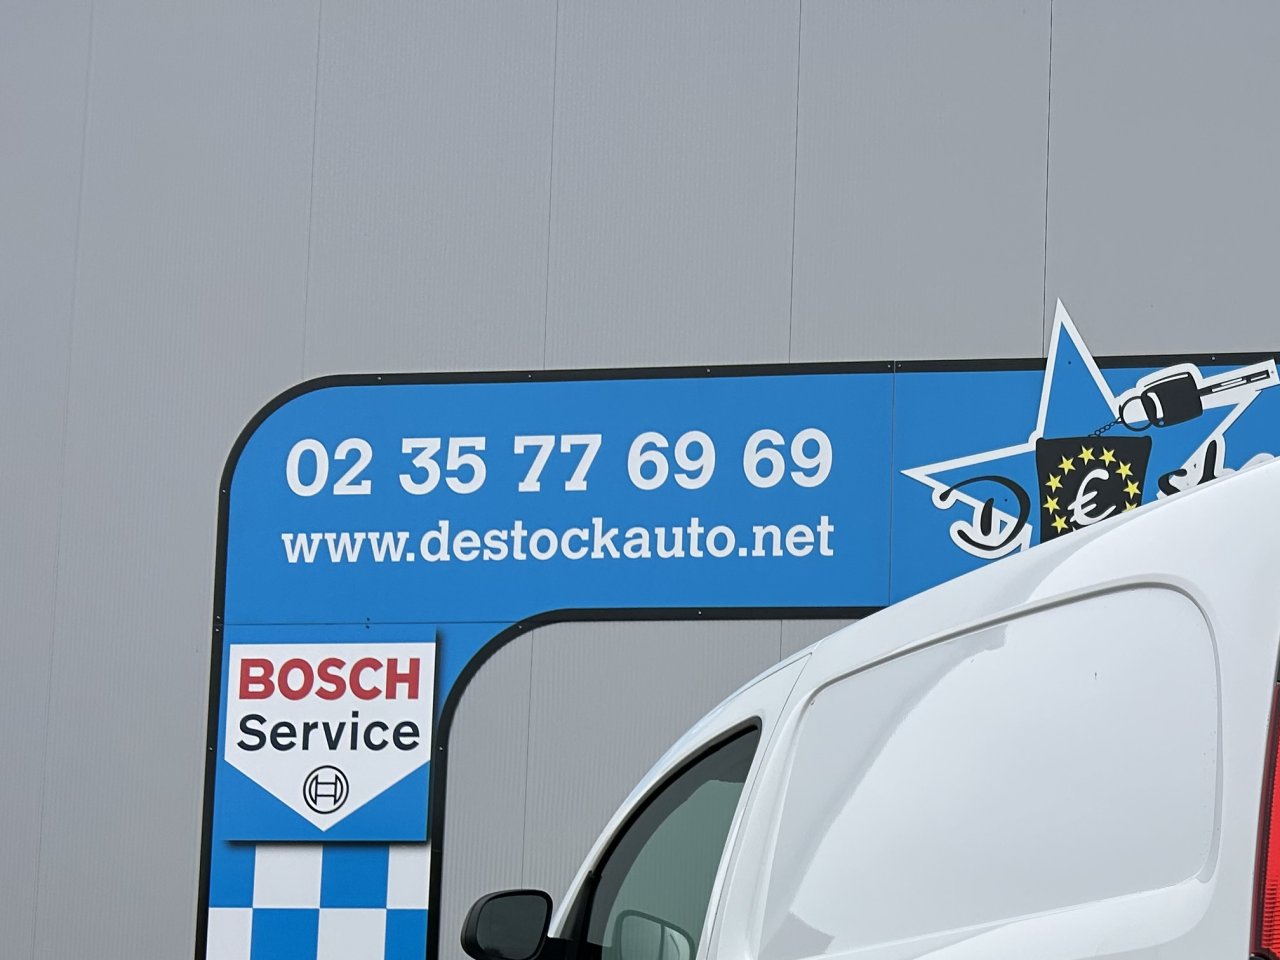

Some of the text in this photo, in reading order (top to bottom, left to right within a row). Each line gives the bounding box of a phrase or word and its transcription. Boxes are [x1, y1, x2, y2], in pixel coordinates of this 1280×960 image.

[287, 428, 832, 496] 02 35 77 69 69
[282, 516, 834, 563] www.destockauto.net
[239, 658, 420, 700] BOSCH
[236, 710, 420, 752] Service
